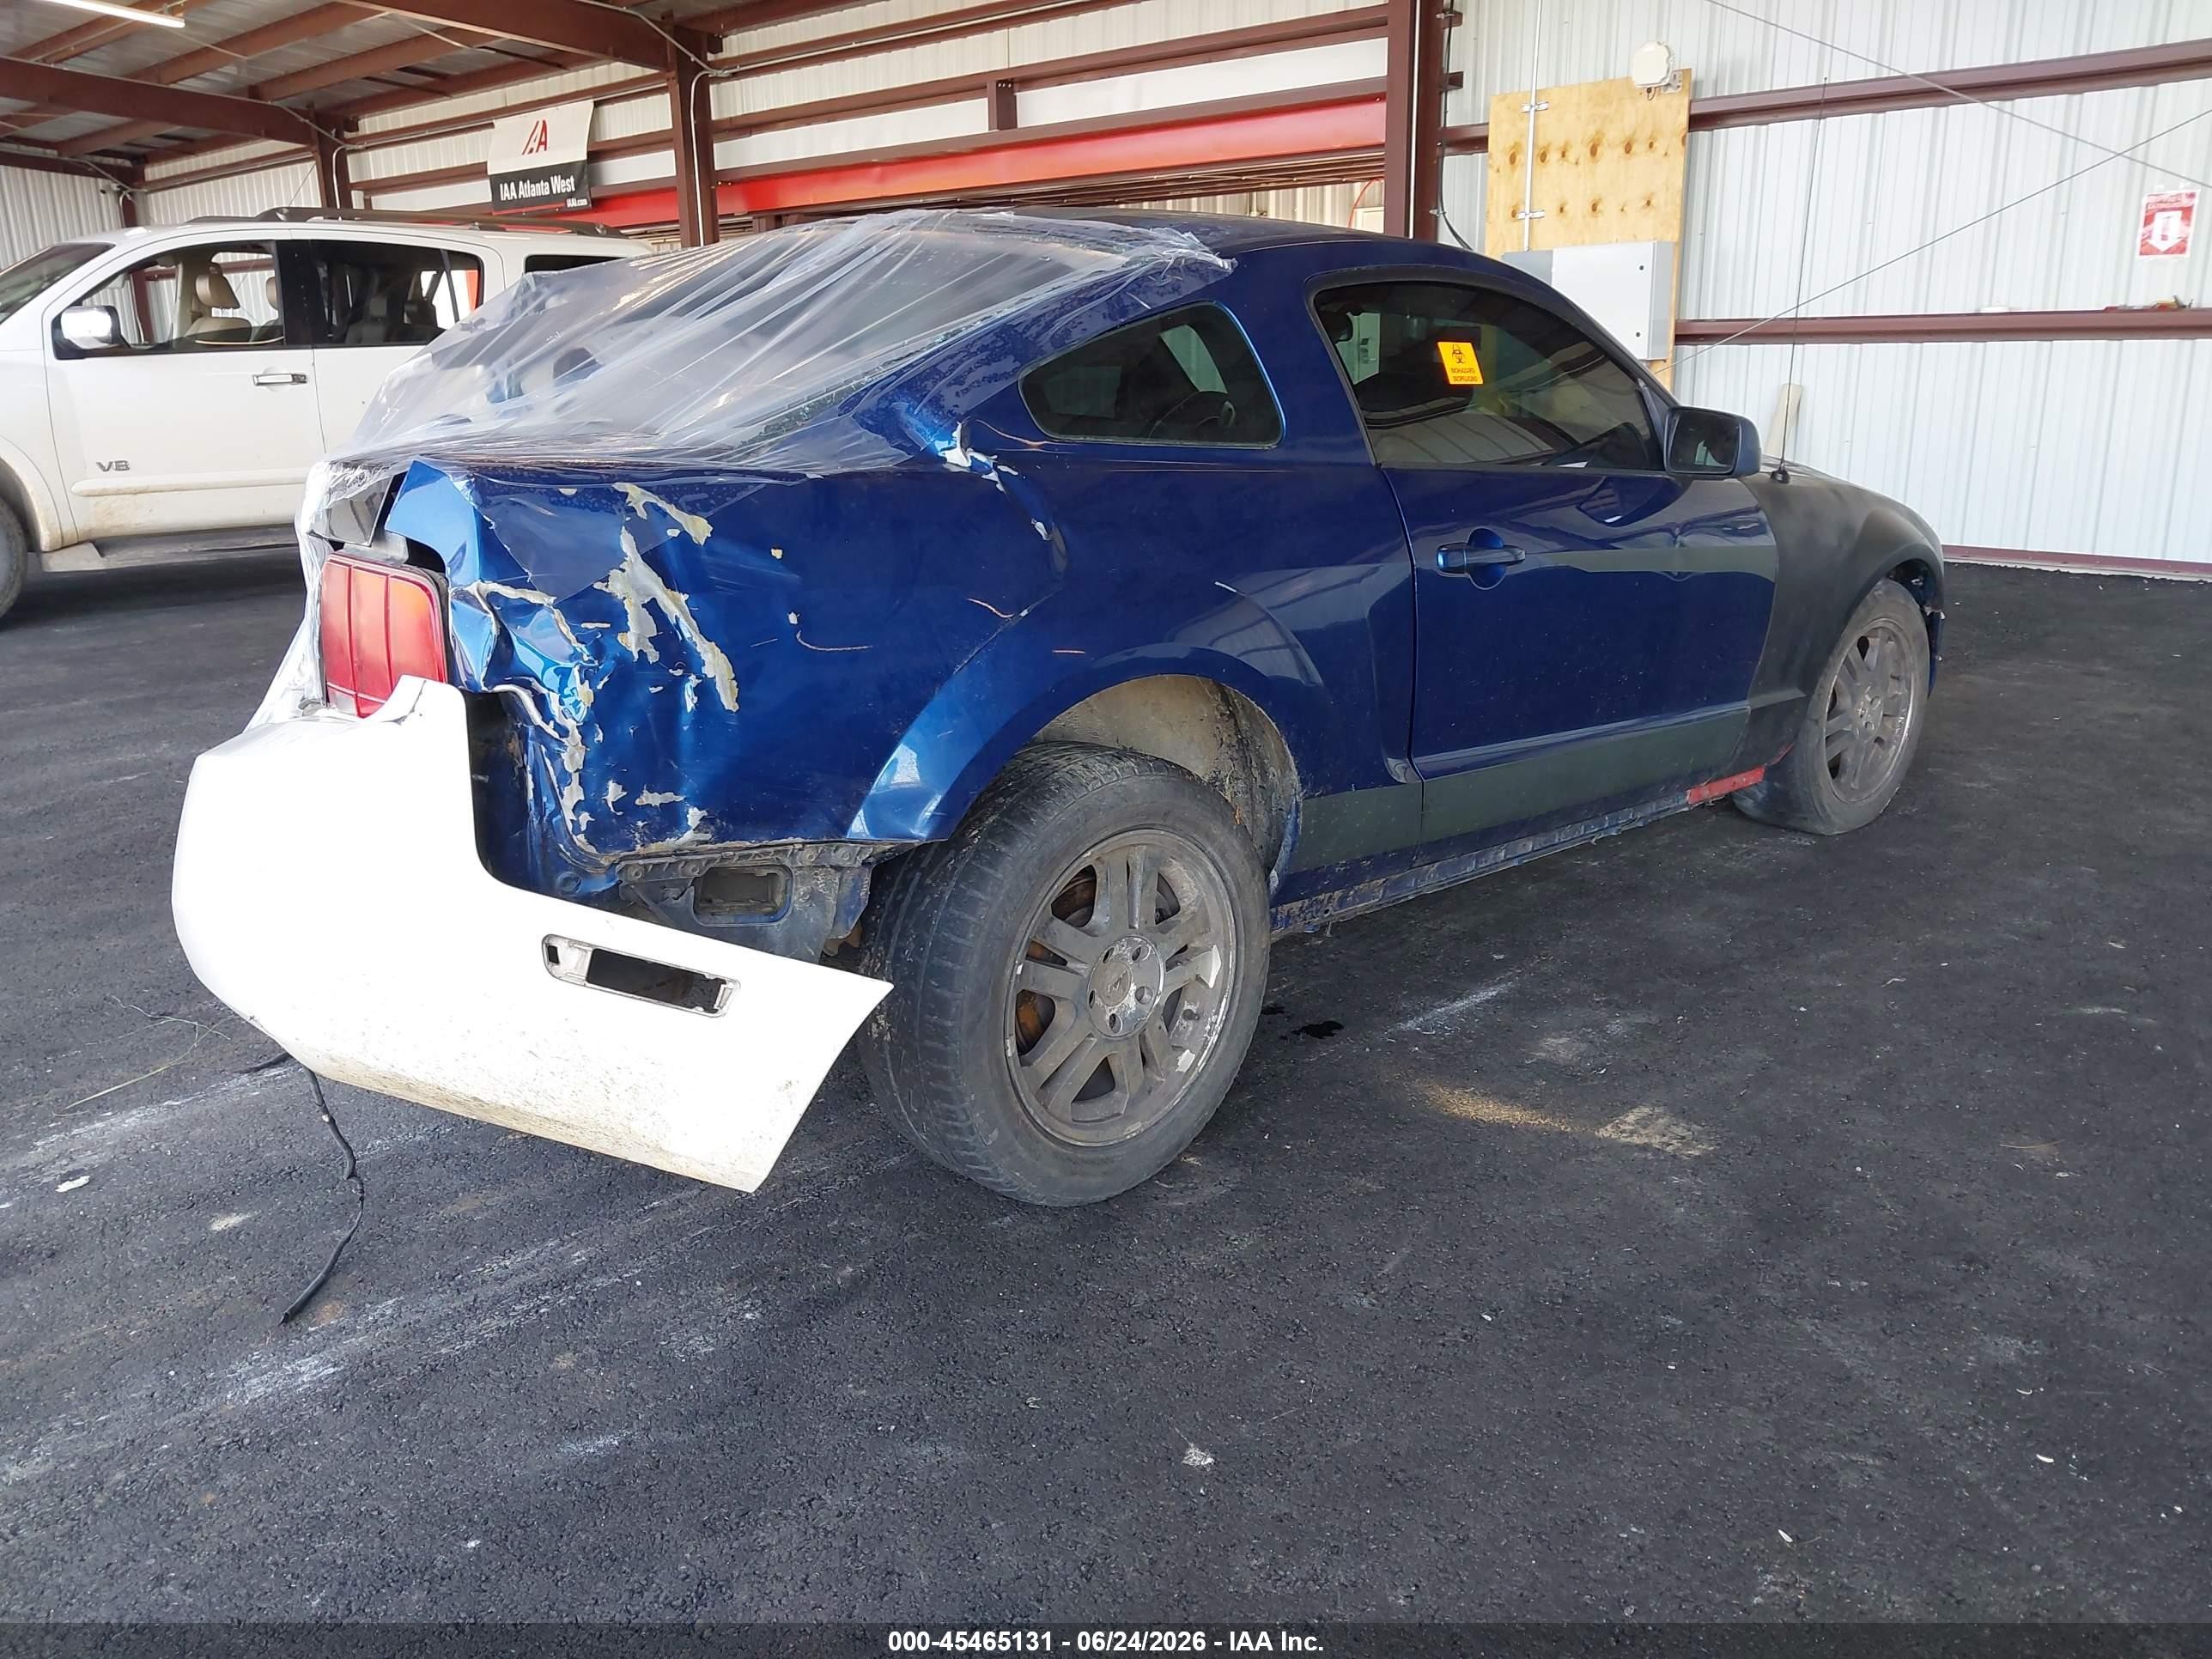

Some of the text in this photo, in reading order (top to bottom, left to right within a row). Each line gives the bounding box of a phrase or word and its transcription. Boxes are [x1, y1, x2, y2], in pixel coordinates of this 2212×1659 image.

[500, 174, 575, 201] IAA Atlanta West
